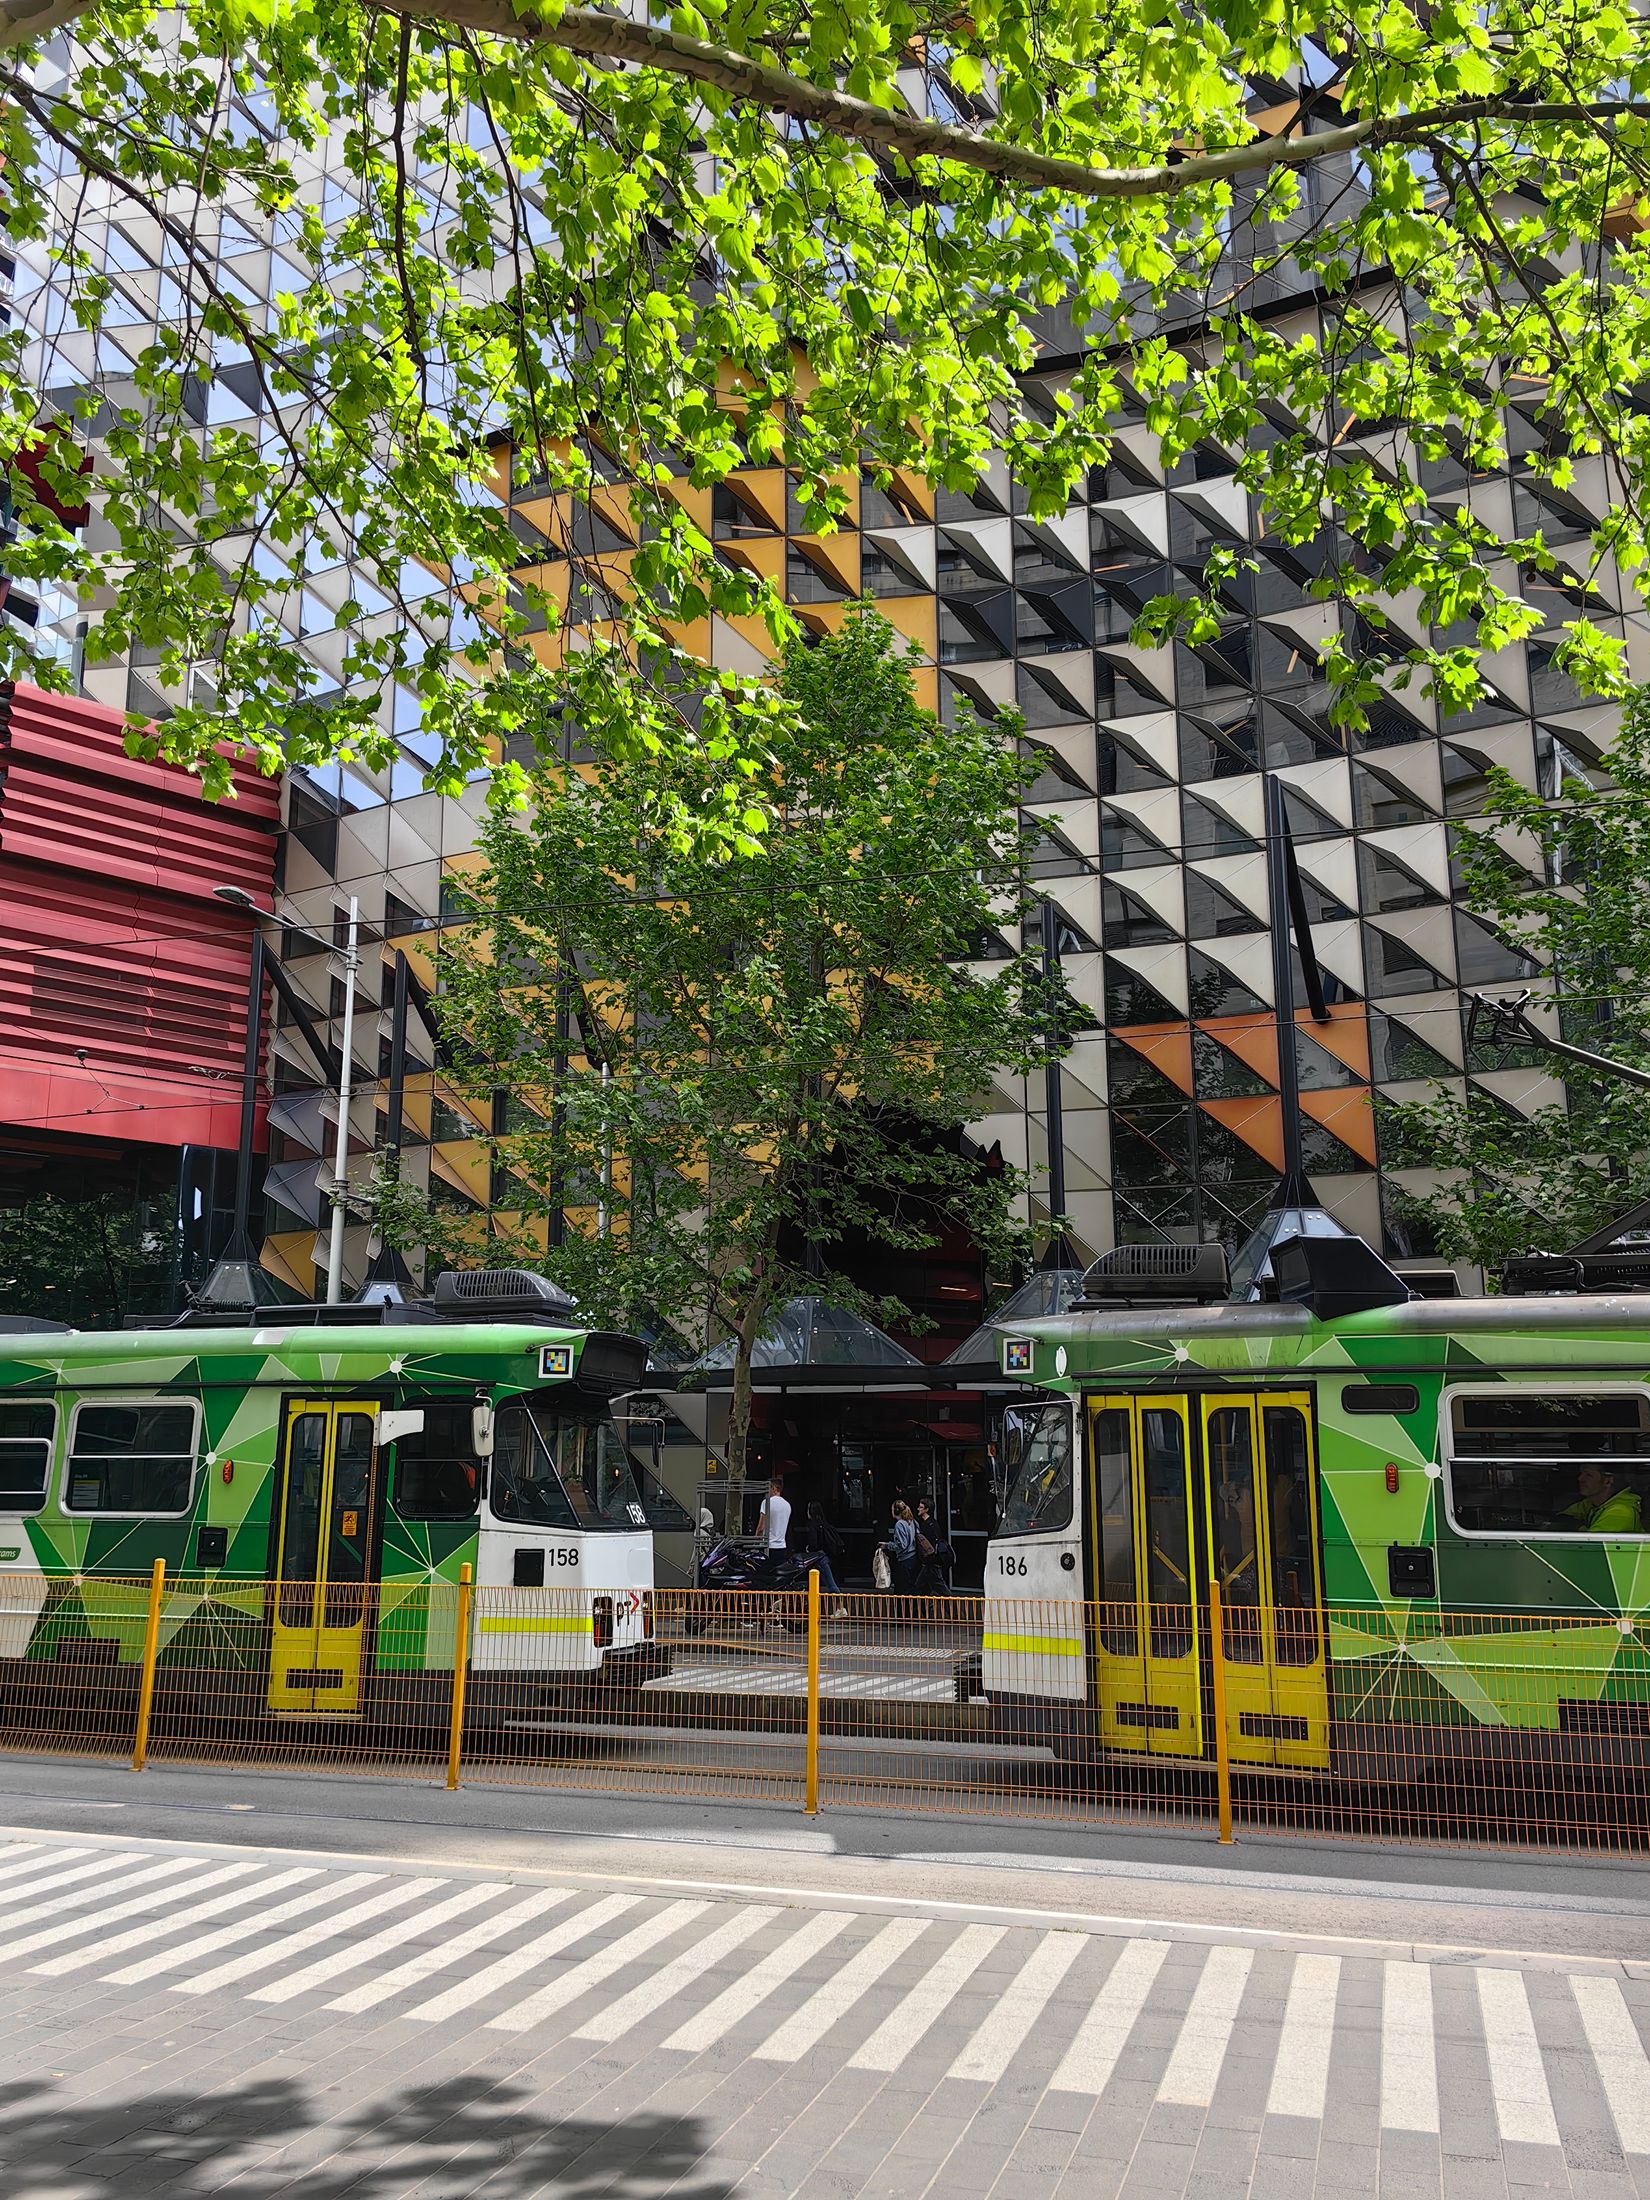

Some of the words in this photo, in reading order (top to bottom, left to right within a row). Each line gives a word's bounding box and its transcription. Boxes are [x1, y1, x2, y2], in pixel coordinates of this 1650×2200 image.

[626, 1504, 646, 1524] 158
[548, 1548, 579, 1567] 158
[998, 1555, 1028, 1577] 186
